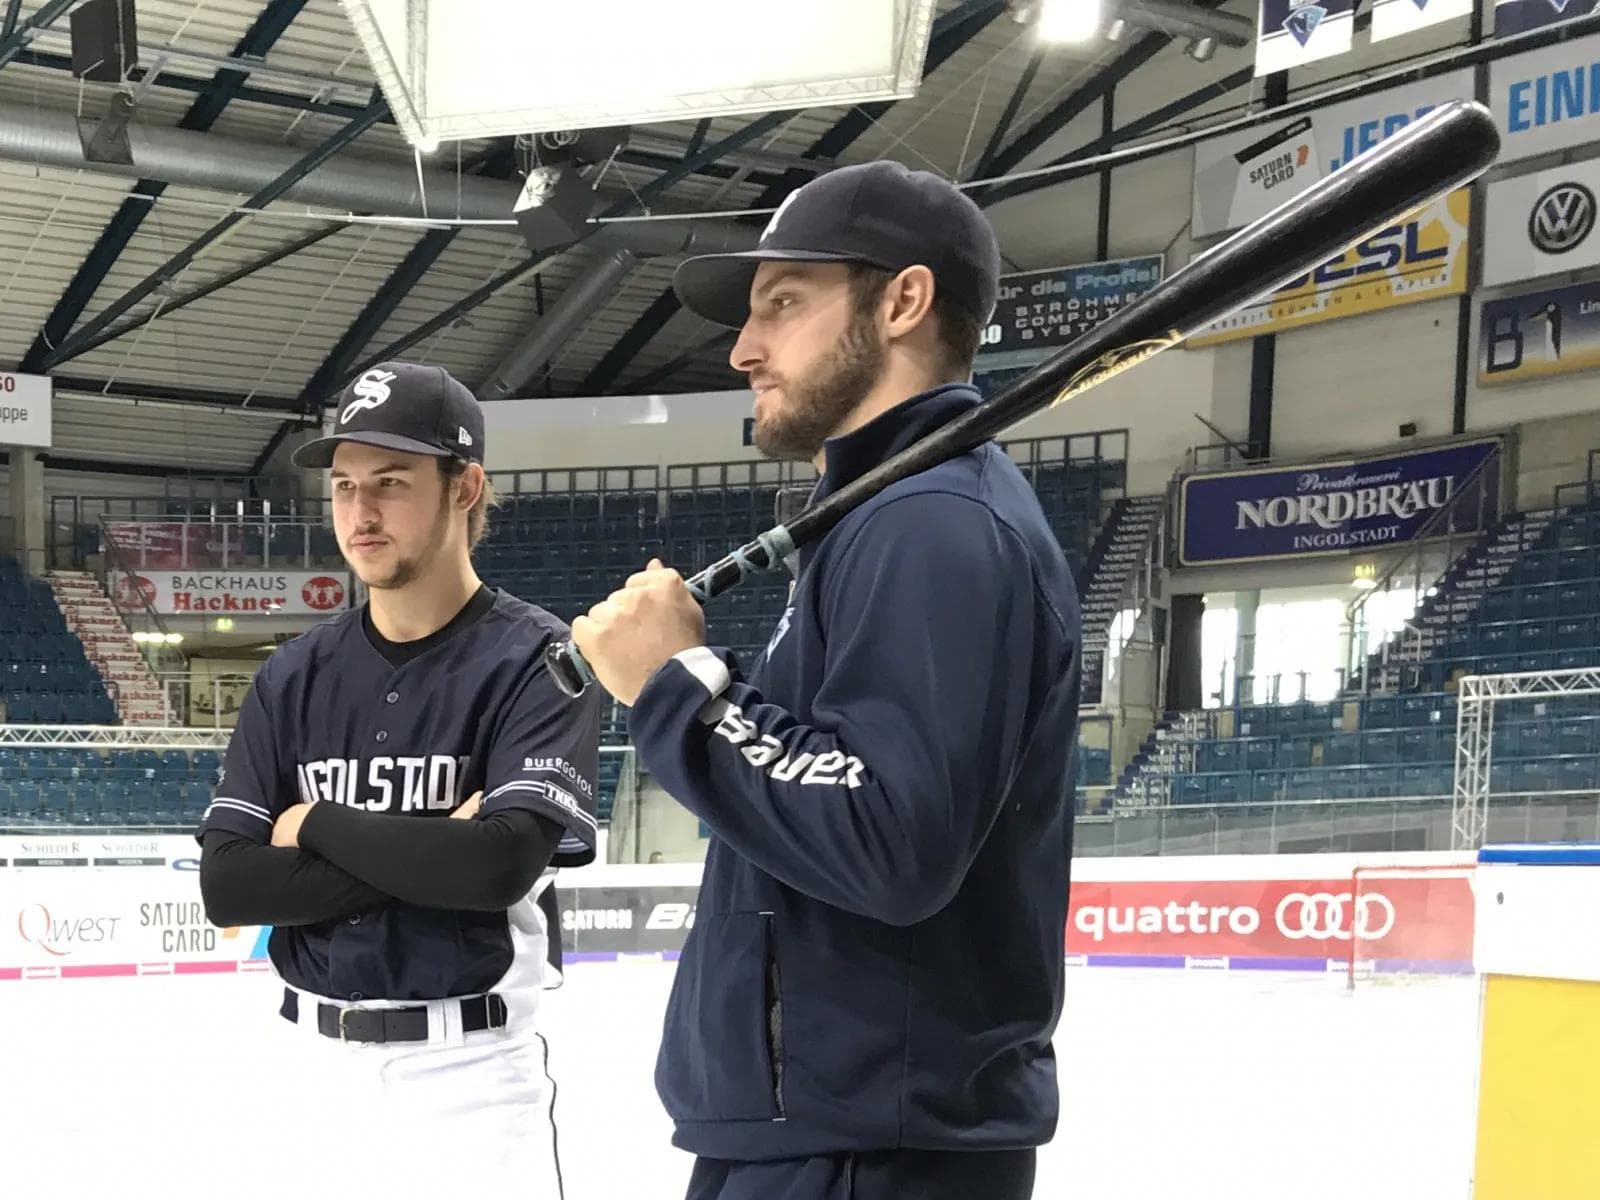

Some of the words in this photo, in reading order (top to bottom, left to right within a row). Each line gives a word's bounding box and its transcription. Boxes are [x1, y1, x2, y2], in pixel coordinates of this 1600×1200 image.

[1250, 152, 1293, 184] SATURN
[1264, 165, 1294, 190] CARD
[1031, 278, 1067, 297] die
[1235, 475, 1454, 530] NORDBRÄU
[1294, 525, 1400, 549] INGOLSTADT
[172, 576, 288, 591] BACKHAUS
[173, 592, 287, 612] Hackner
[562, 908, 633, 930] SATURN
[1074, 901, 1260, 941] quattro
[162, 928, 216, 953] CARD
